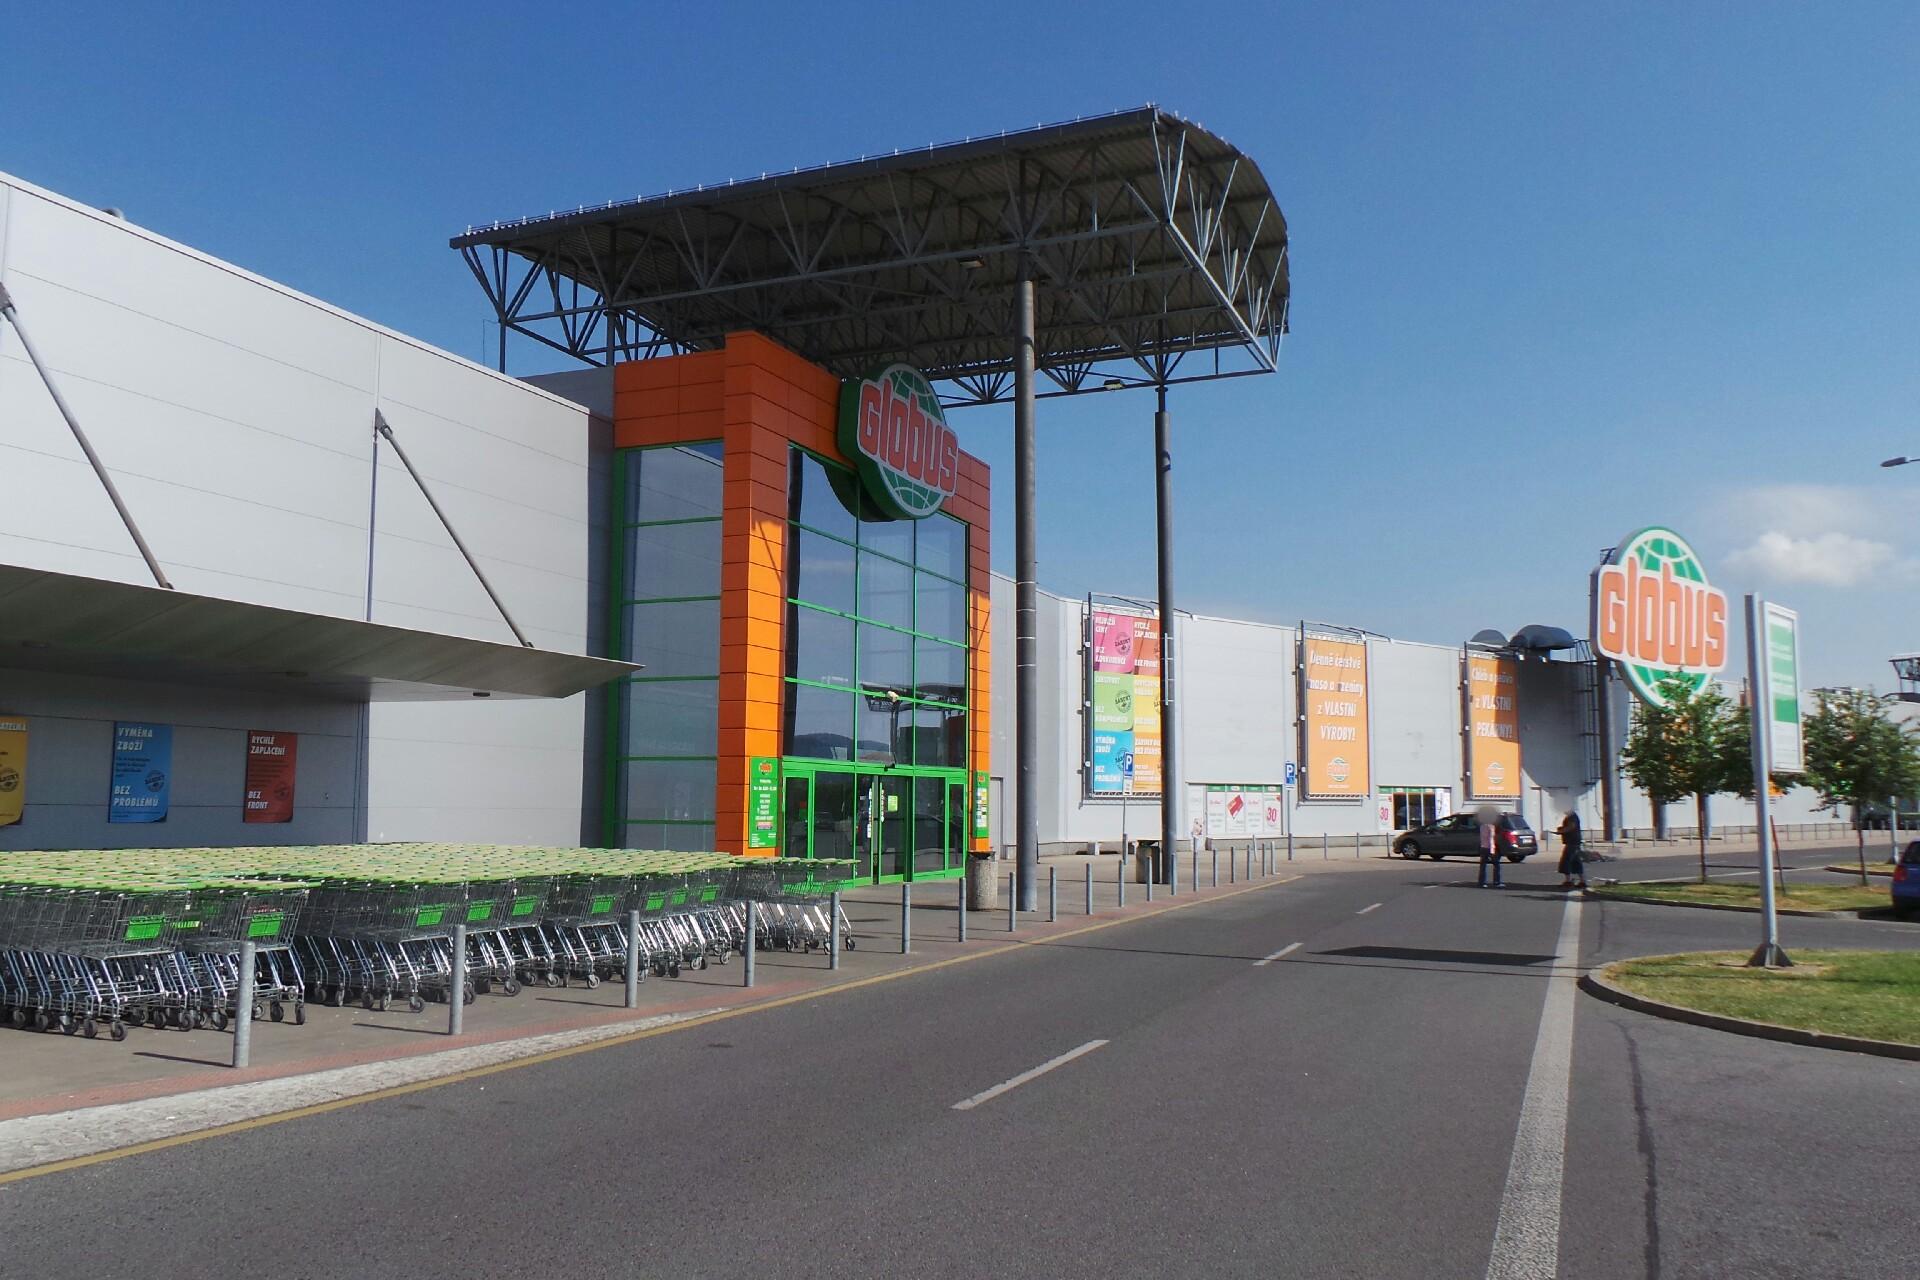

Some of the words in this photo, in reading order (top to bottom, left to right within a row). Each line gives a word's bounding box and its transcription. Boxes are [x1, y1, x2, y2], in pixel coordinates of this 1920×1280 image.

[859, 377, 957, 493] Globus
[1600, 556, 1725, 667] Globus
[1126, 755, 1132, 770] P
[1287, 765, 1294, 777] P
[1267, 807, 1277, 822] 30
[1380, 807, 1389, 821] 30
